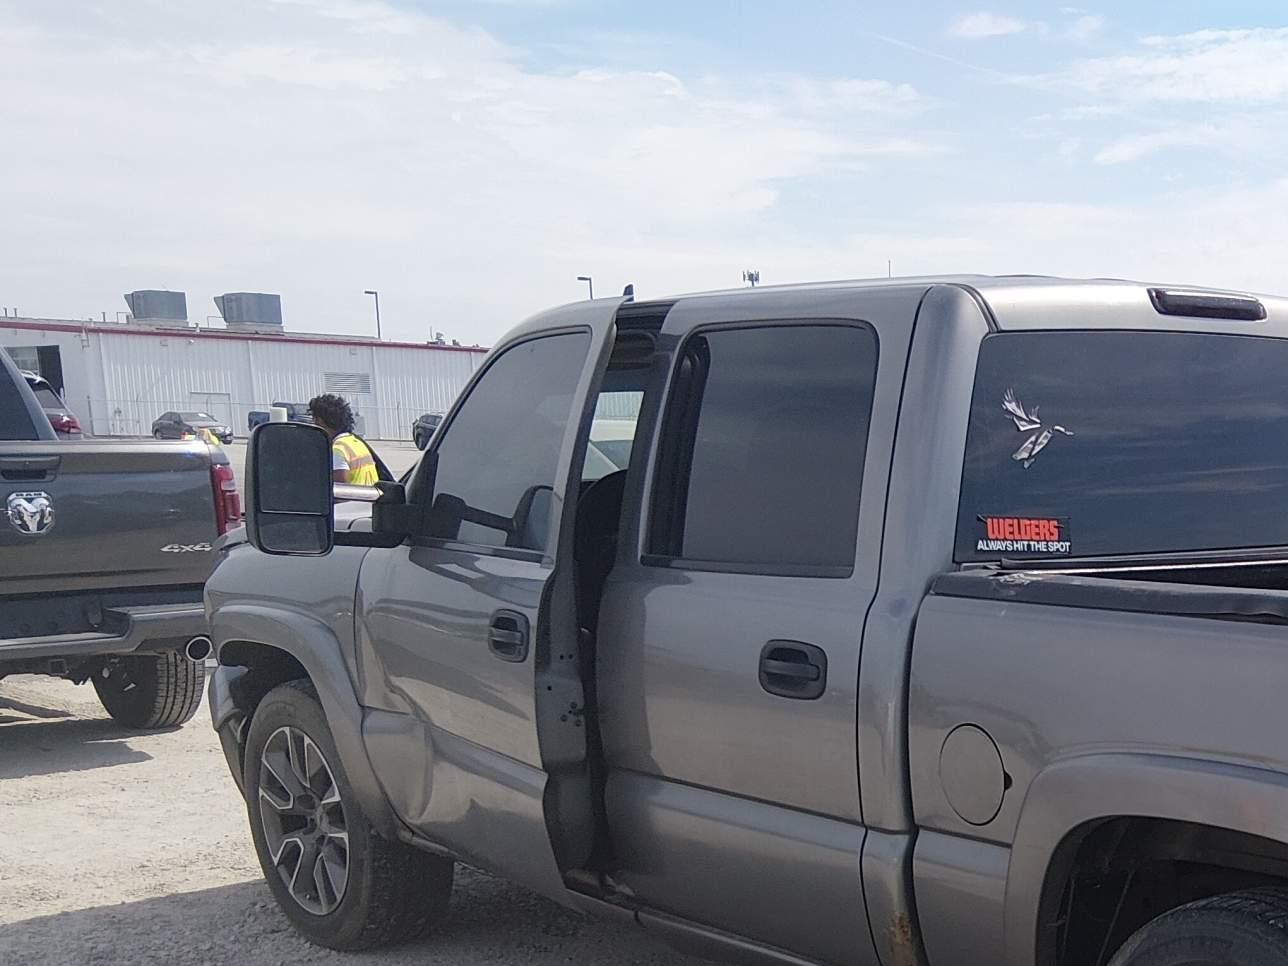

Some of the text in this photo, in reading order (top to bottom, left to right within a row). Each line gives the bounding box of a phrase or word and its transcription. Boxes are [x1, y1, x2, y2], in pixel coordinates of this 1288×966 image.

[986, 517, 1060, 541] WELDERS
[977, 540, 1071, 553] ALWAYS HIT THE SPOT
